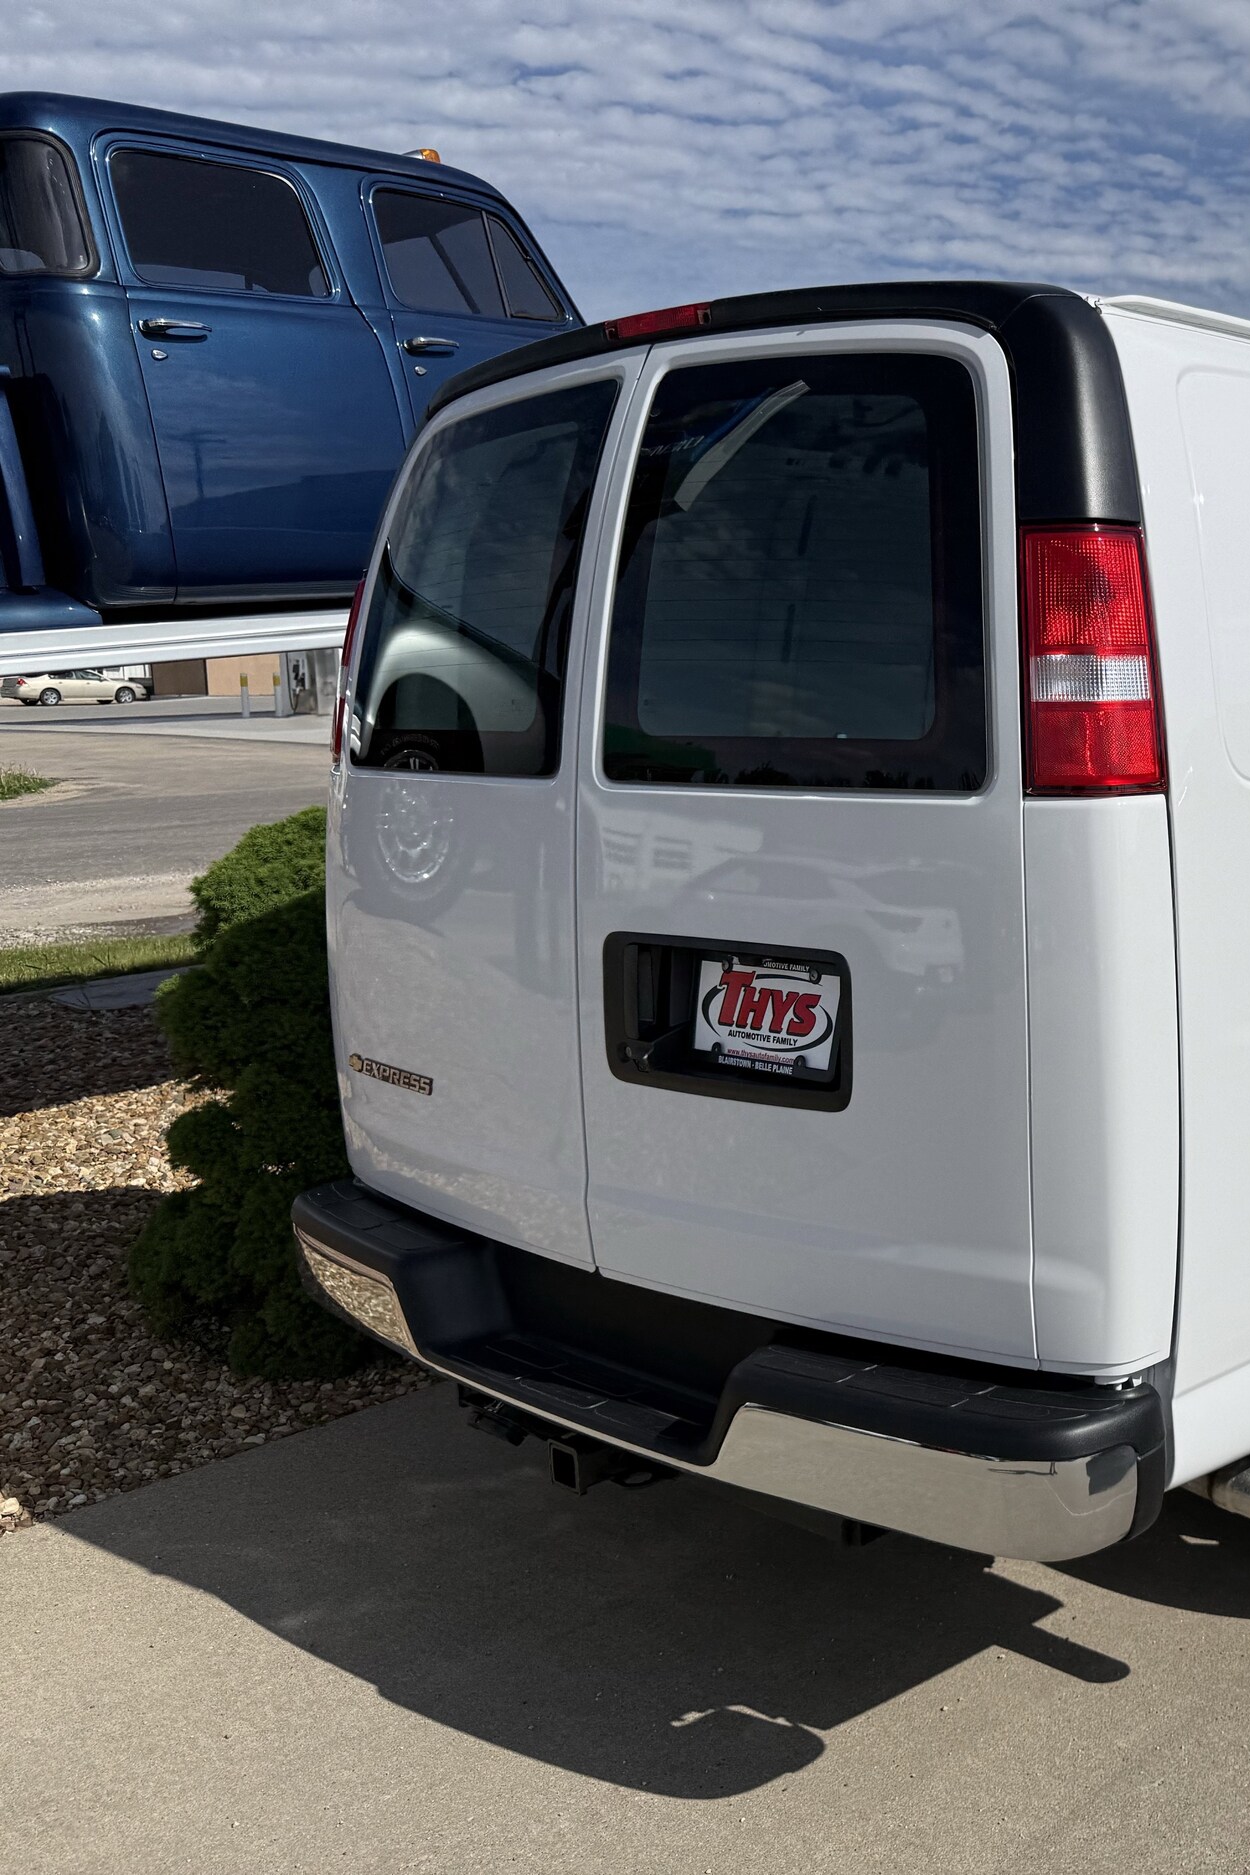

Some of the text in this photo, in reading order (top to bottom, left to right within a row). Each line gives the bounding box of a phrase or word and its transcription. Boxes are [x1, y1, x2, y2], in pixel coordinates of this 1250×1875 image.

[789, 963, 810, 972] FAMILY
[717, 970, 822, 1037] THYS
[727, 1030, 799, 1047] AUTOMOTIVE FAMILY
[727, 1047, 795, 1064] www.thysautofamily.com
[718, 1055, 752, 1069] BLAIRSTOWN
[755, 1061, 772, 1072] BELLE
[772, 1063, 794, 1075] PLAINE
[363, 1059, 430, 1095] EXPRESS
